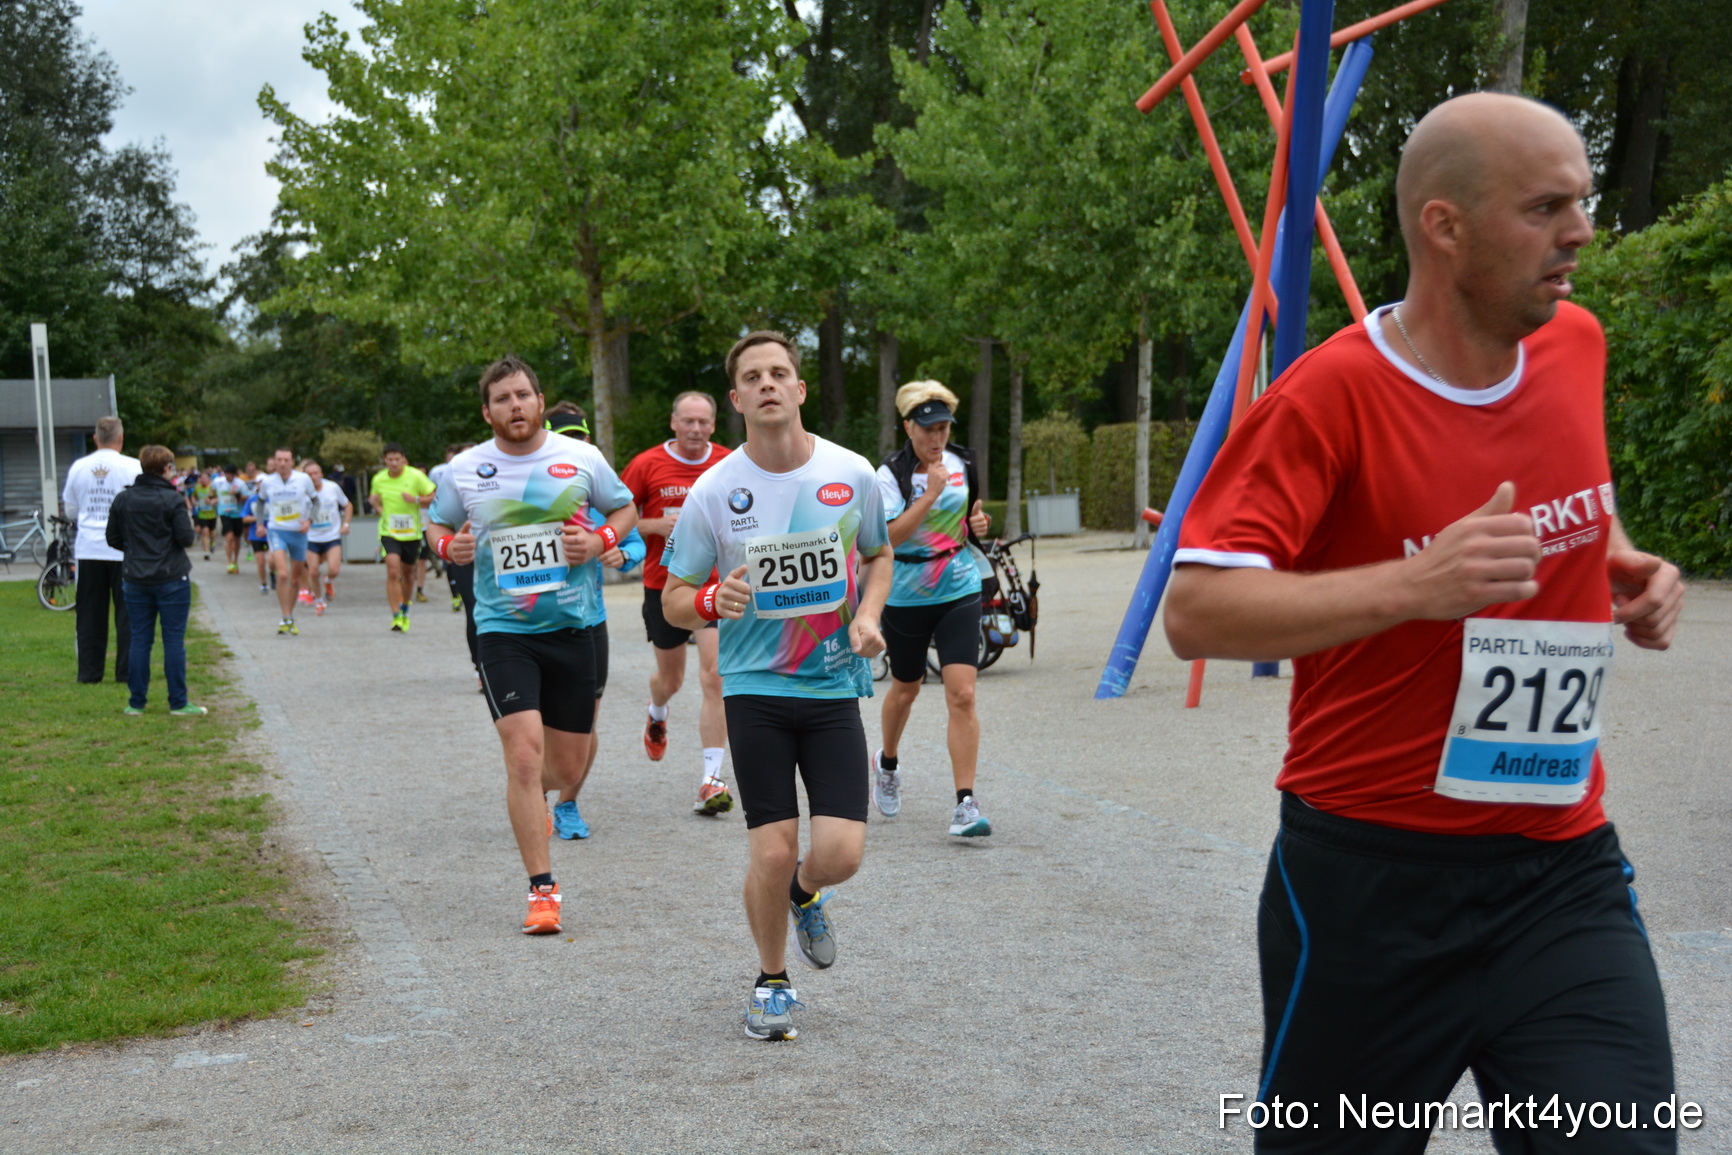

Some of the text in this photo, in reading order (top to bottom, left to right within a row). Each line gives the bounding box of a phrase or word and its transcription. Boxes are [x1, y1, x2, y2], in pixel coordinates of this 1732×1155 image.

[477, 481, 500, 489] PARTL
[821, 489, 850, 500] Hervis
[730, 516, 758, 528] PARTL
[732, 524, 759, 533] Neumarkt
[492, 530, 552, 543] PARTL Neumarkt
[748, 537, 828, 554] PARTL Neumarkt
[501, 539, 559, 570] 2541
[759, 548, 838, 587] 2505
[516, 574, 551, 585] Markus
[774, 589, 830, 607] Christian
[823, 638, 840, 653] 16.
[1469, 637, 1529, 655] PARTL
[1474, 666, 1604, 733] 2129
[1457, 725, 1466, 735] B
[1490, 751, 1580, 777] Andreas
